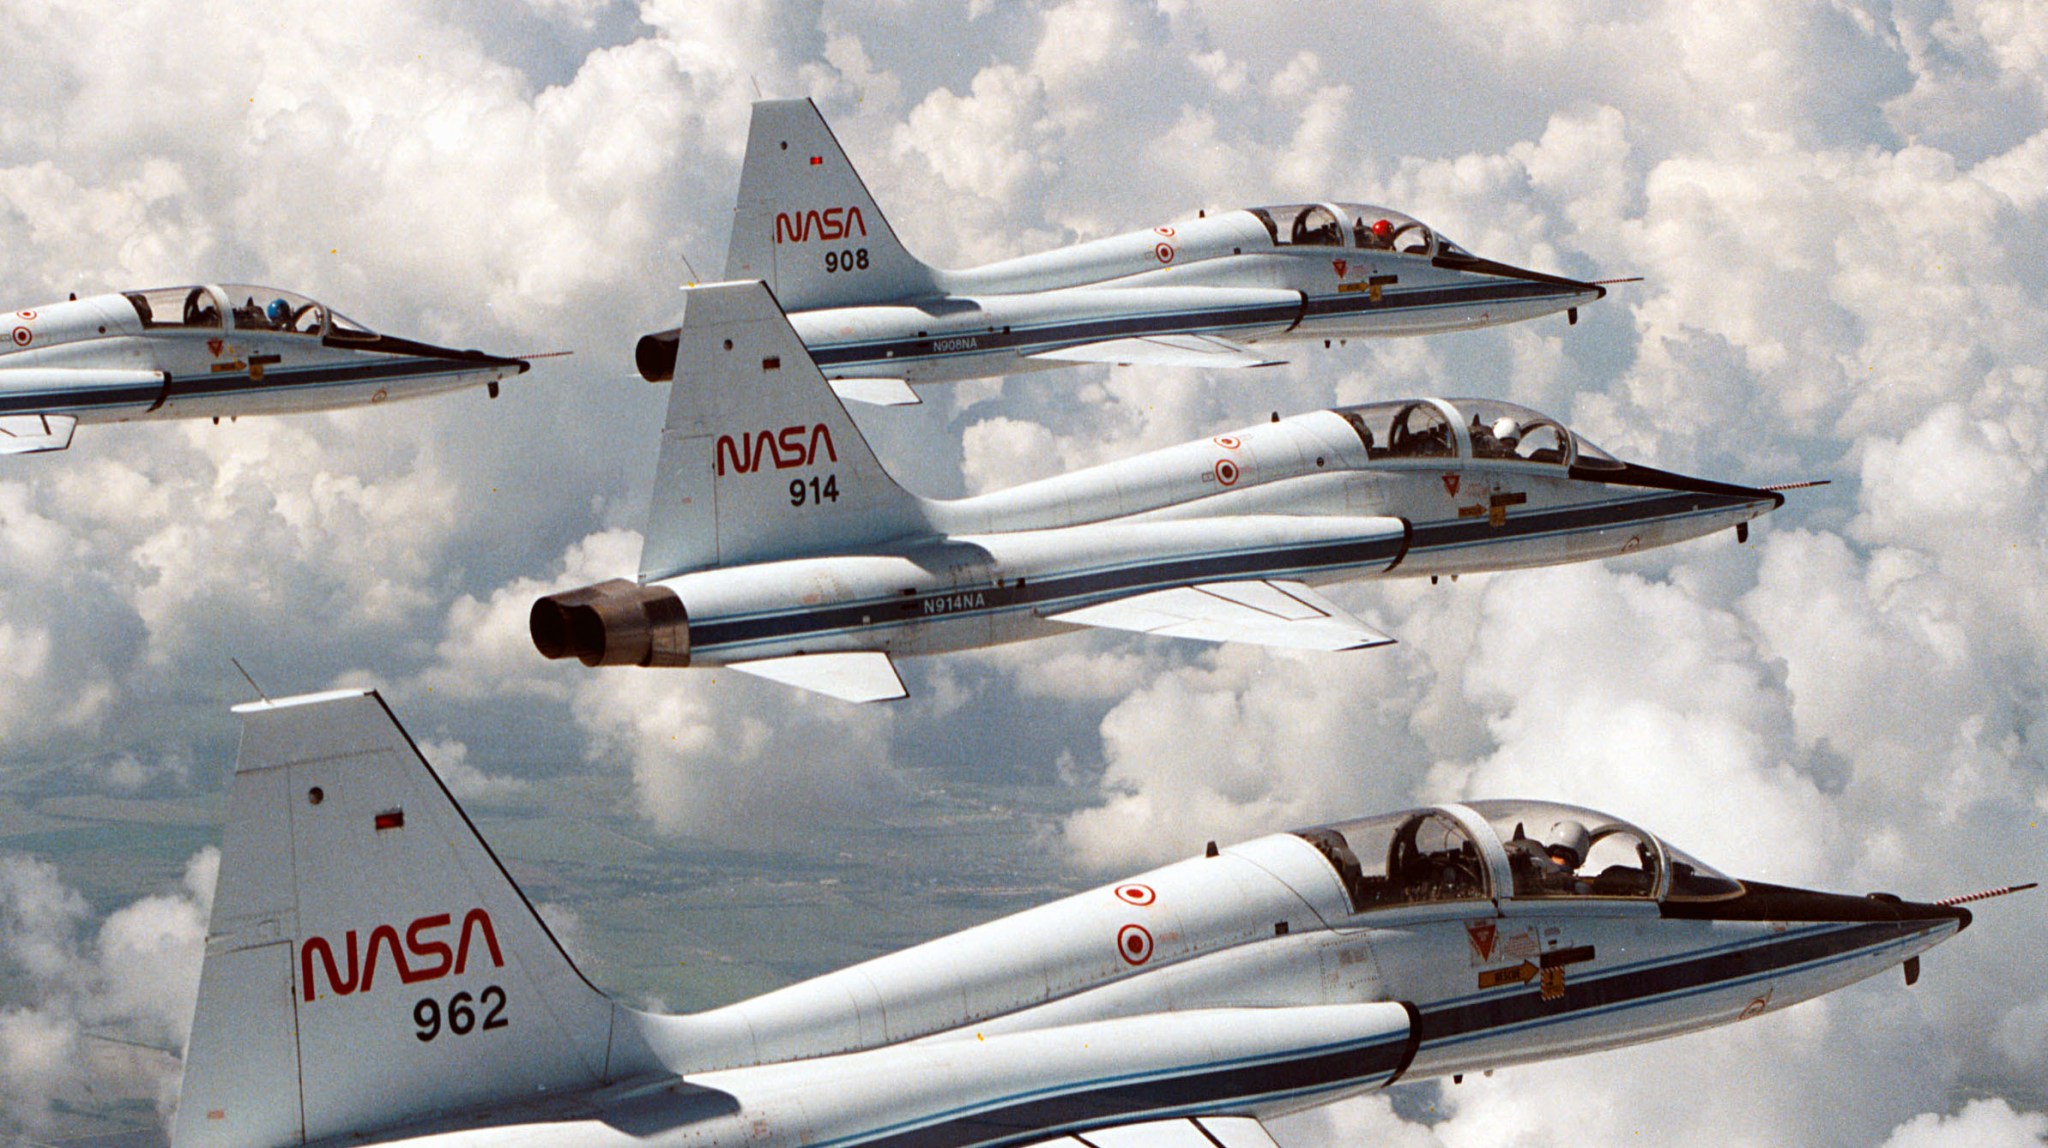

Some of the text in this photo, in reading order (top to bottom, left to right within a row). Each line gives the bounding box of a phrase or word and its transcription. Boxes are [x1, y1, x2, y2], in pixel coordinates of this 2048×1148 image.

[776, 207, 867, 245] NASA
[824, 247, 870, 274] 908
[933, 337, 978, 352] N908NA
[717, 423, 837, 477] NASA
[789, 473, 840, 507] 914
[924, 592, 985, 614] N914NA
[301, 908, 504, 1002] NASA
[412, 984, 509, 1042] 962
